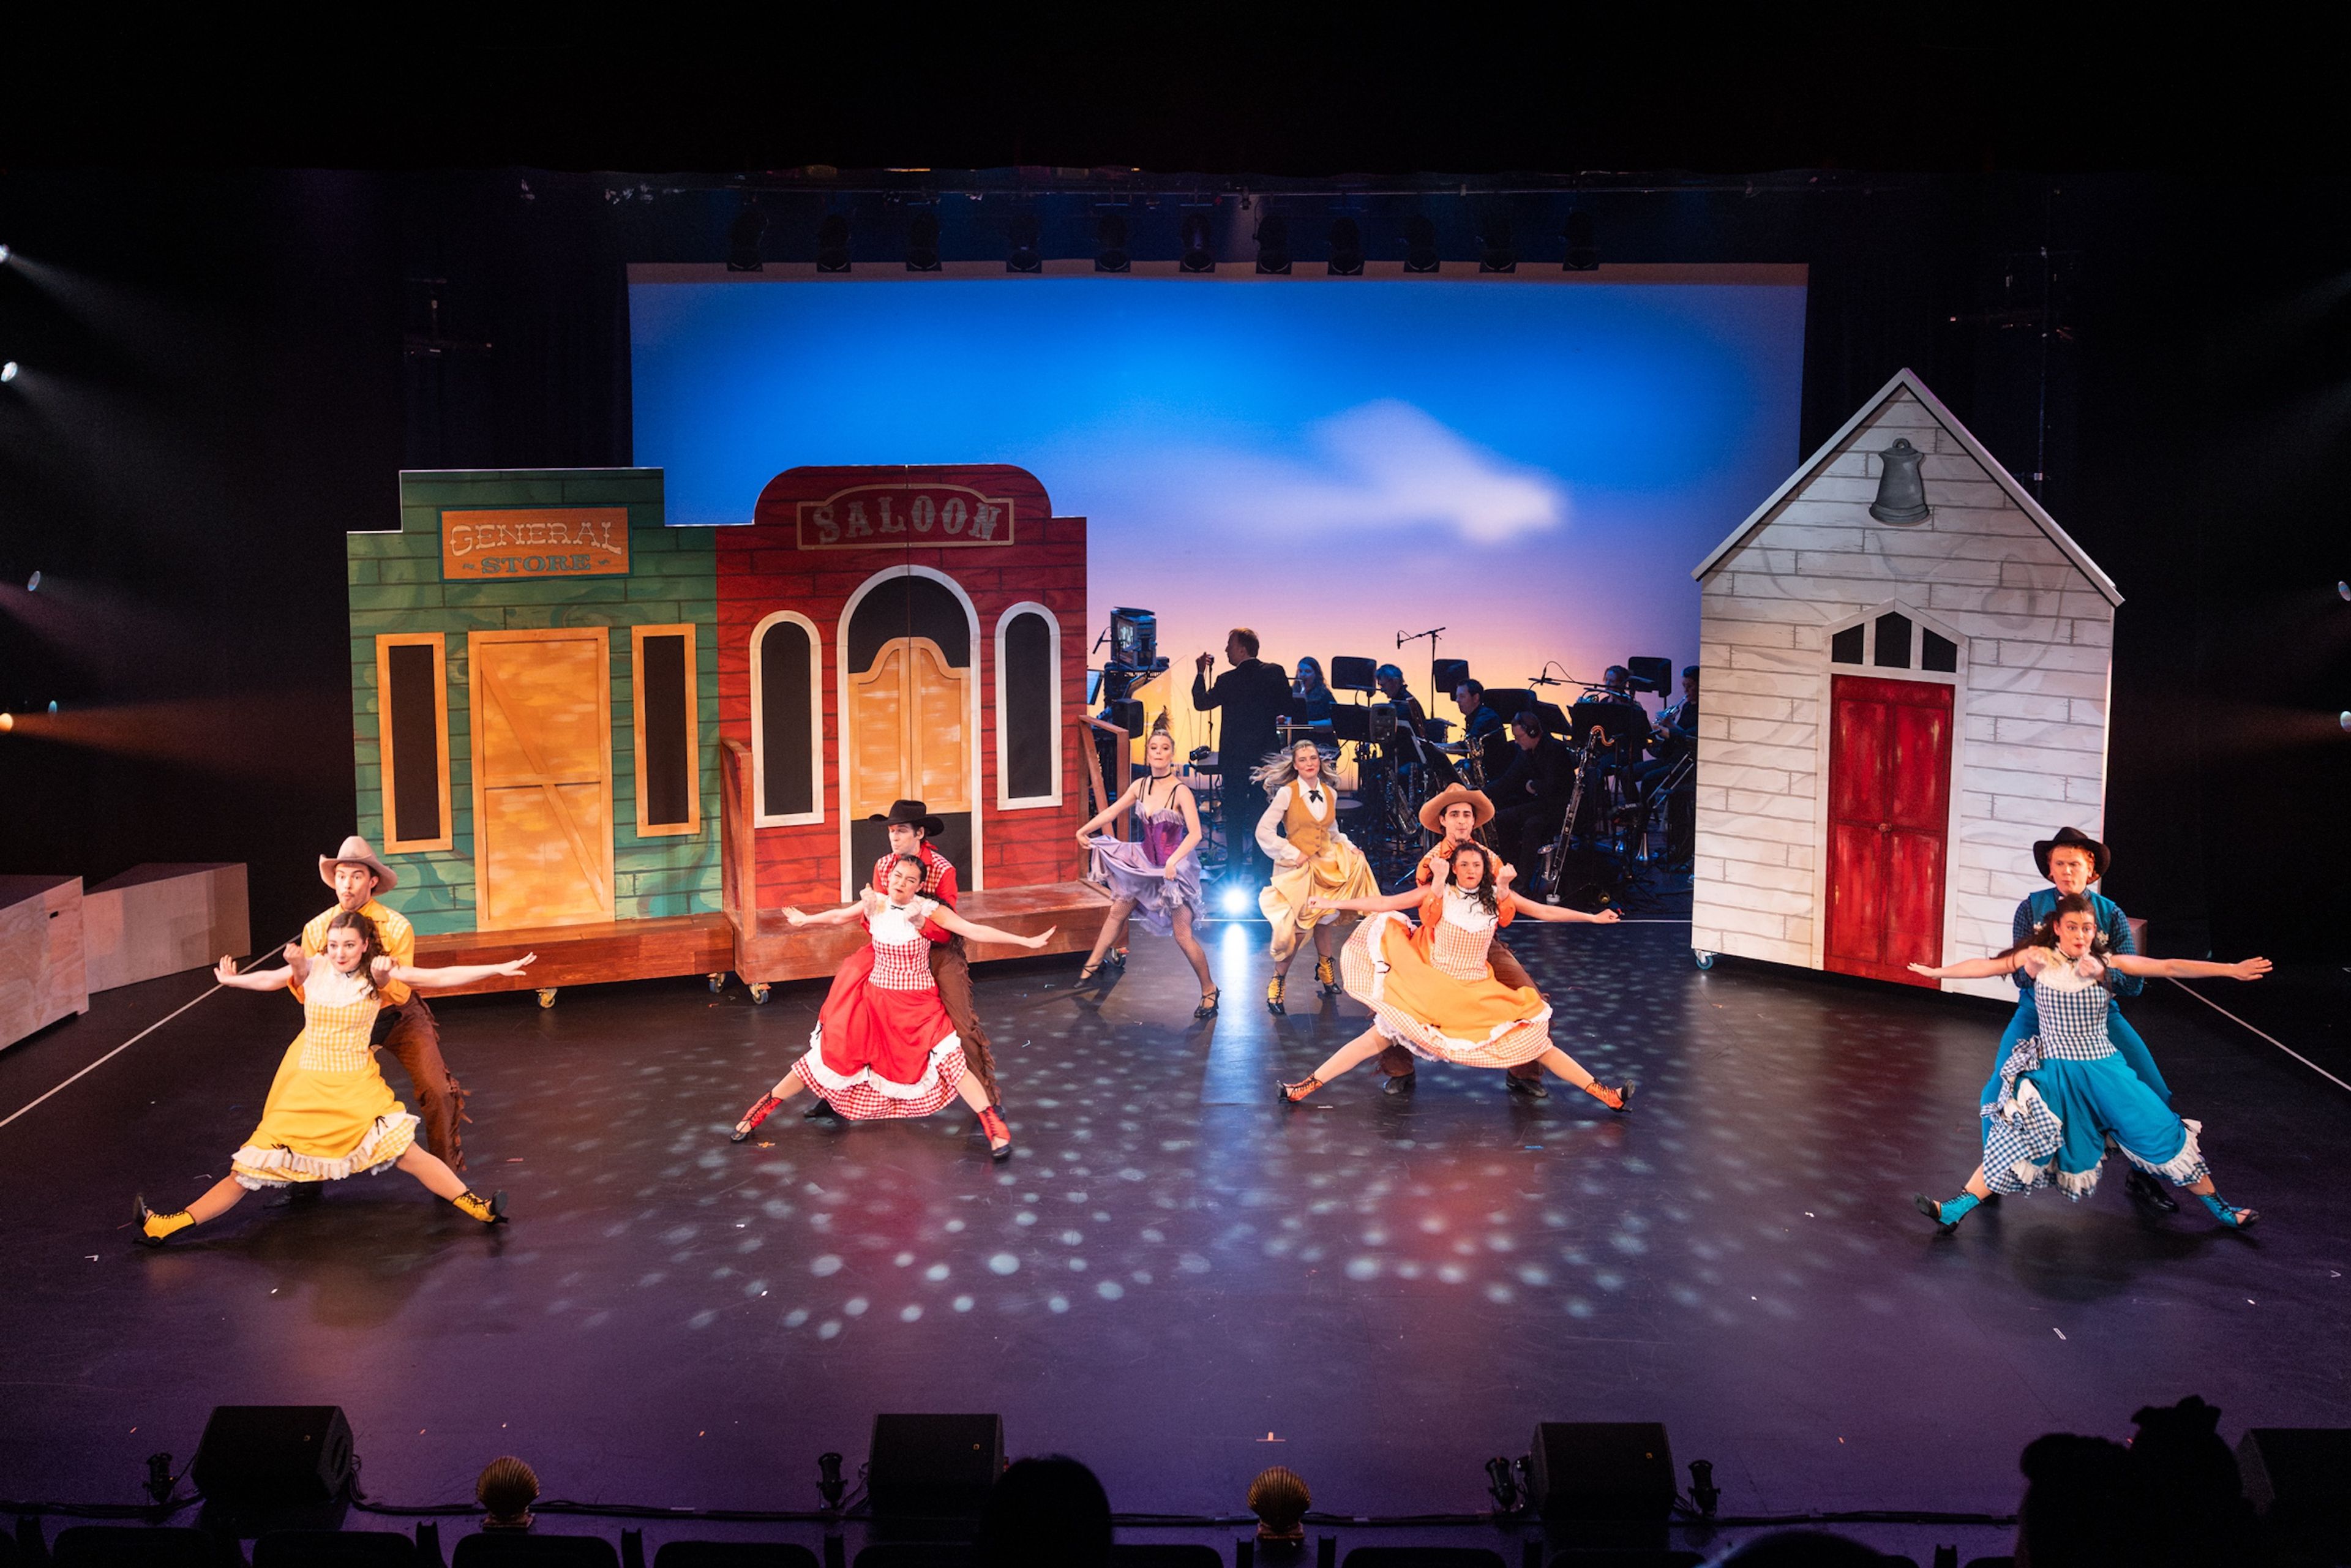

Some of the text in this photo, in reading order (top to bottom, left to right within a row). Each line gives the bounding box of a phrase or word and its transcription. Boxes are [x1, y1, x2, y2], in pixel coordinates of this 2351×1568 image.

[813, 495, 1002, 544] SALOON
[449, 522, 623, 557] GENERAL
[481, 554, 591, 574] STORE
